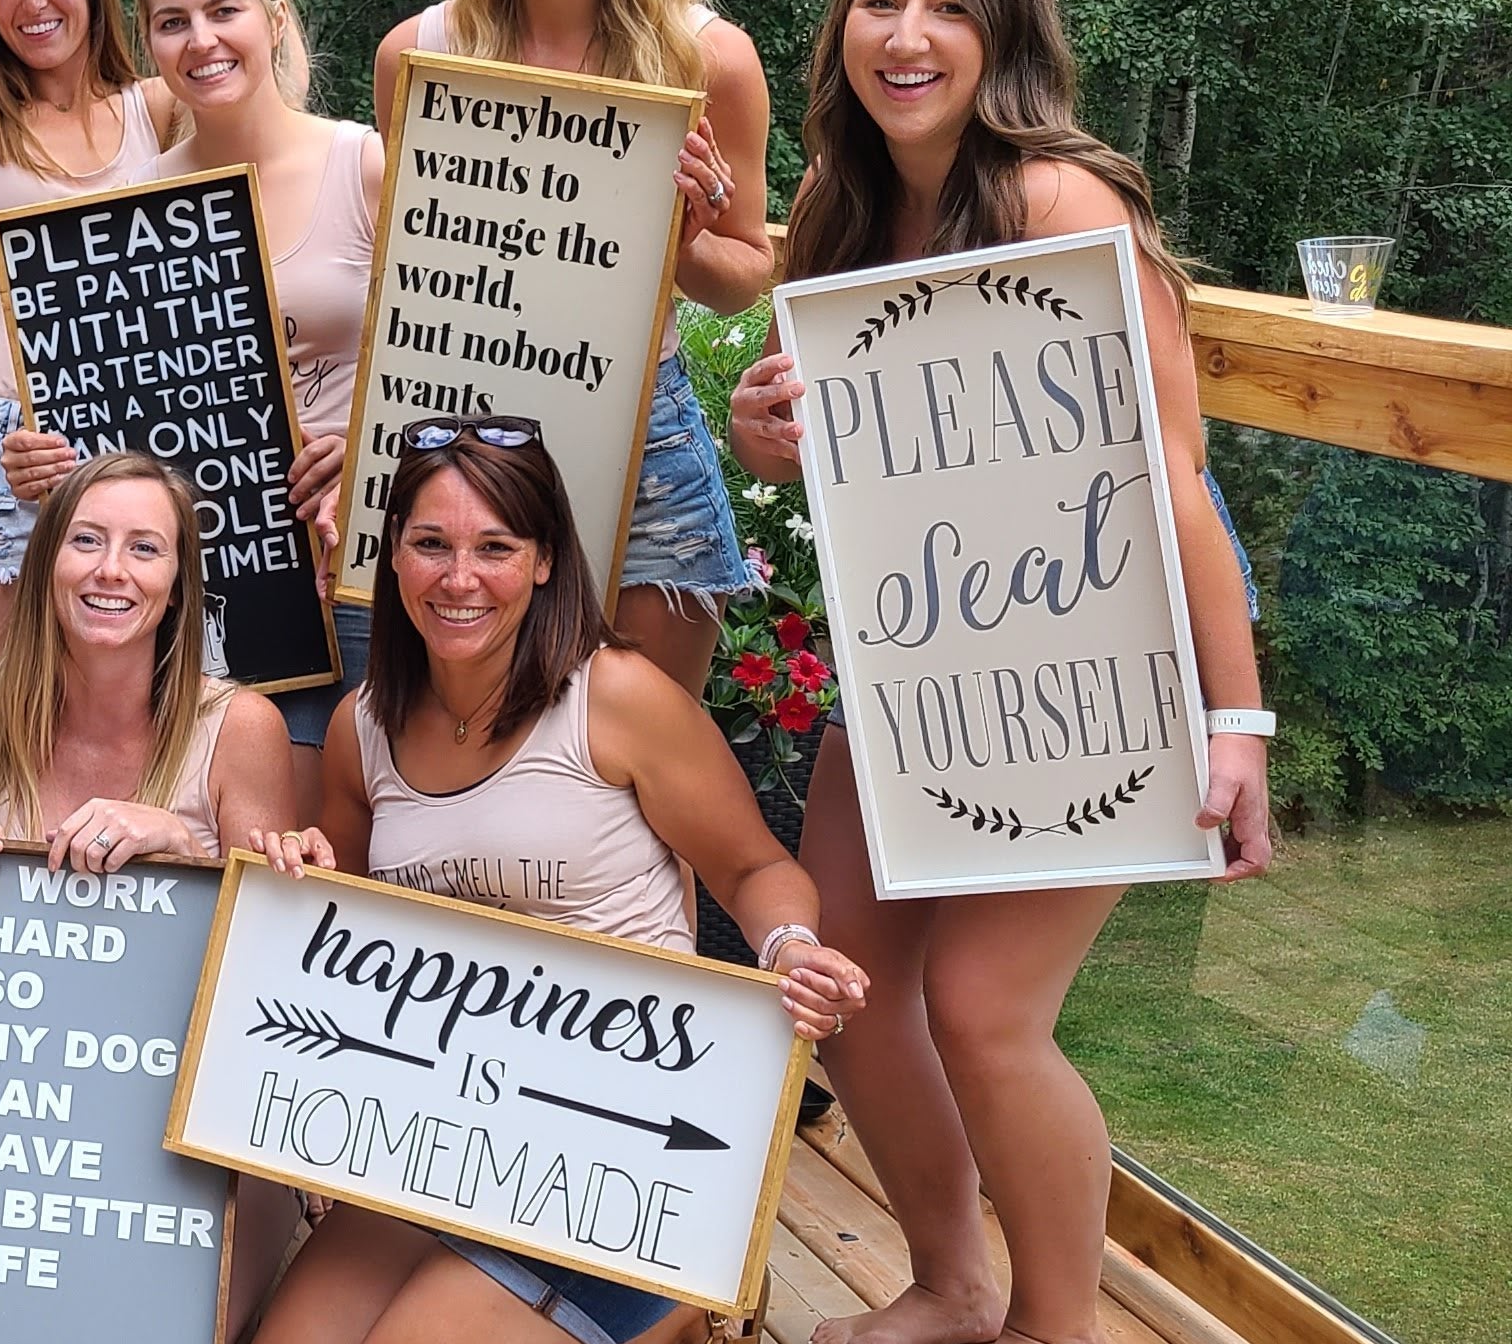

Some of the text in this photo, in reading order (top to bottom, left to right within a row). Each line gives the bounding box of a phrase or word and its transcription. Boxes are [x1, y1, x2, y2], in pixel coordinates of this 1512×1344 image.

[419, 80, 642, 160] Everybody
[412, 148, 580, 203] wants to
[1, 189, 242, 281] PLEASE
[403, 198, 621, 269] change the
[10, 246, 247, 321] BE PATIENT
[396, 261, 523, 318] world,
[17, 305, 151, 365] WITH
[155, 285, 256, 338] THE
[387, 307, 614, 391] but nobody
[26, 334, 263, 405] BARTENDER
[33, 395, 112, 434] EVEN
[125, 394, 145, 420] A
[162, 371, 269, 416] TOILET
[380, 372, 495, 417] wants
[74, 403, 275, 466] AN ONLY
[814, 331, 1142, 486] PLEASE
[195, 446, 286, 493] ONE
[201, 532, 300, 583] TIME!
[858, 469, 1151, 650] Seat
[872, 650, 1182, 776] YOURSELF
[18, 866, 180, 916] WORK
[441, 857, 511, 898] SMELL
[518, 858, 567, 900] THE
[301, 900, 716, 1072] happiness
[64, 1029, 178, 1077] DOG
[456, 1053, 507, 1106] IS
[249, 1070, 694, 1271] HOMEMADE
[2, 1189, 215, 1250] BETTER
